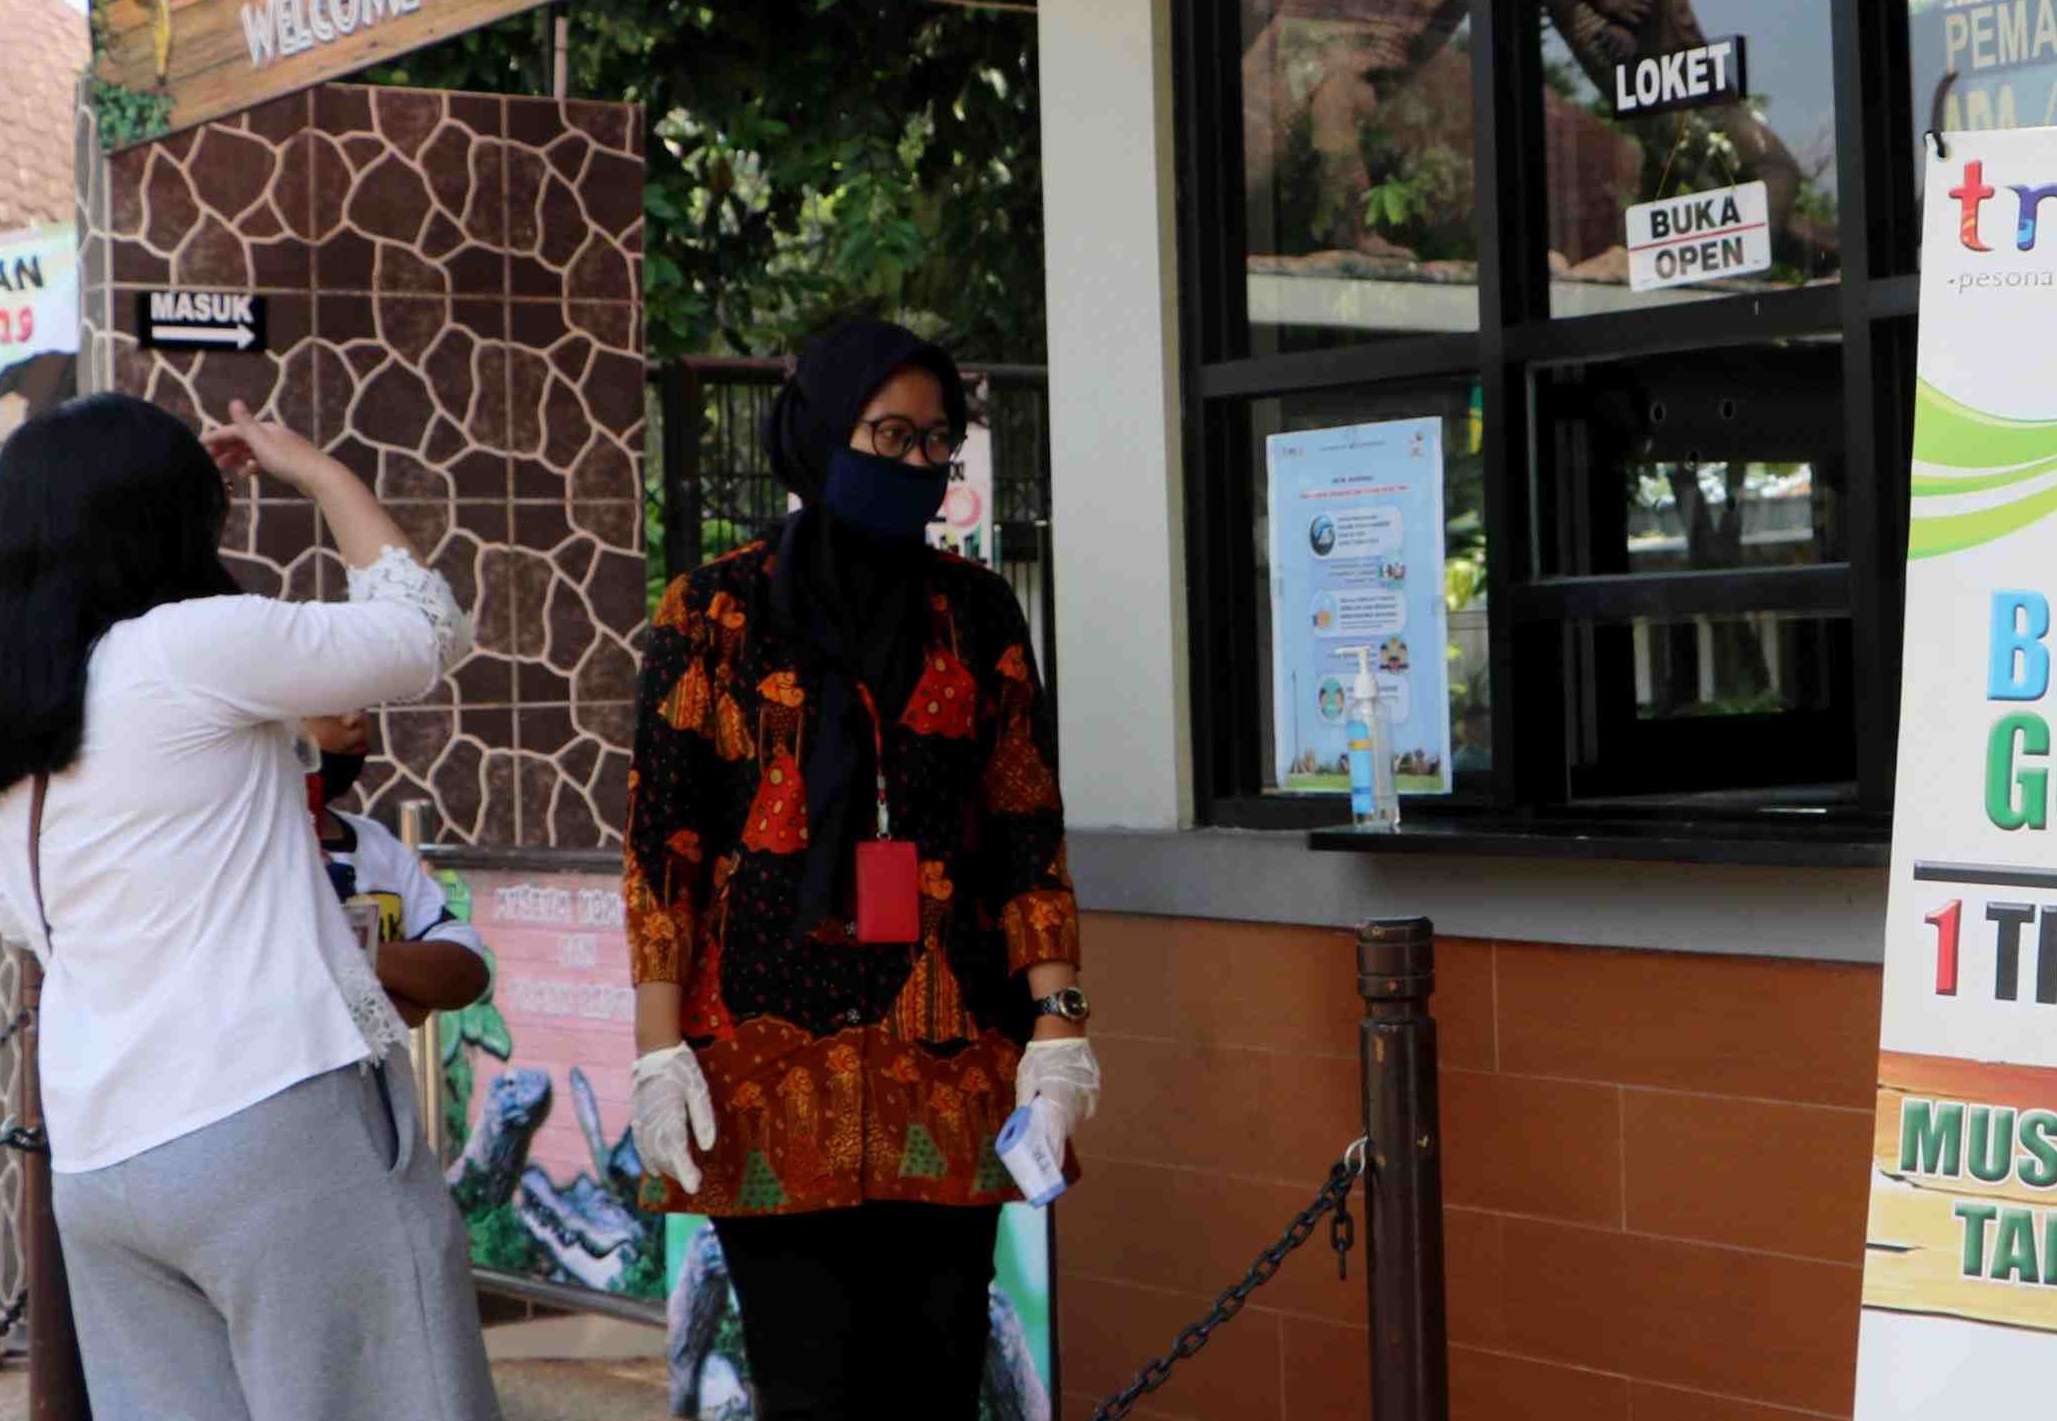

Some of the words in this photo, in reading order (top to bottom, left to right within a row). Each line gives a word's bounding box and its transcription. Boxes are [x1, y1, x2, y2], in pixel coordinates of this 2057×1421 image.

[240, 0, 420, 67] WELCO
[1615, 41, 1731, 112] LOKET
[1650, 196, 1741, 240] BUKA
[1655, 237, 1744, 279] OPEN
[150, 292, 254, 323] MASUK
[1924, 899, 1962, 996] 1
[1900, 1098, 2057, 1189] MUS
[1953, 1201, 2057, 1286] TA
